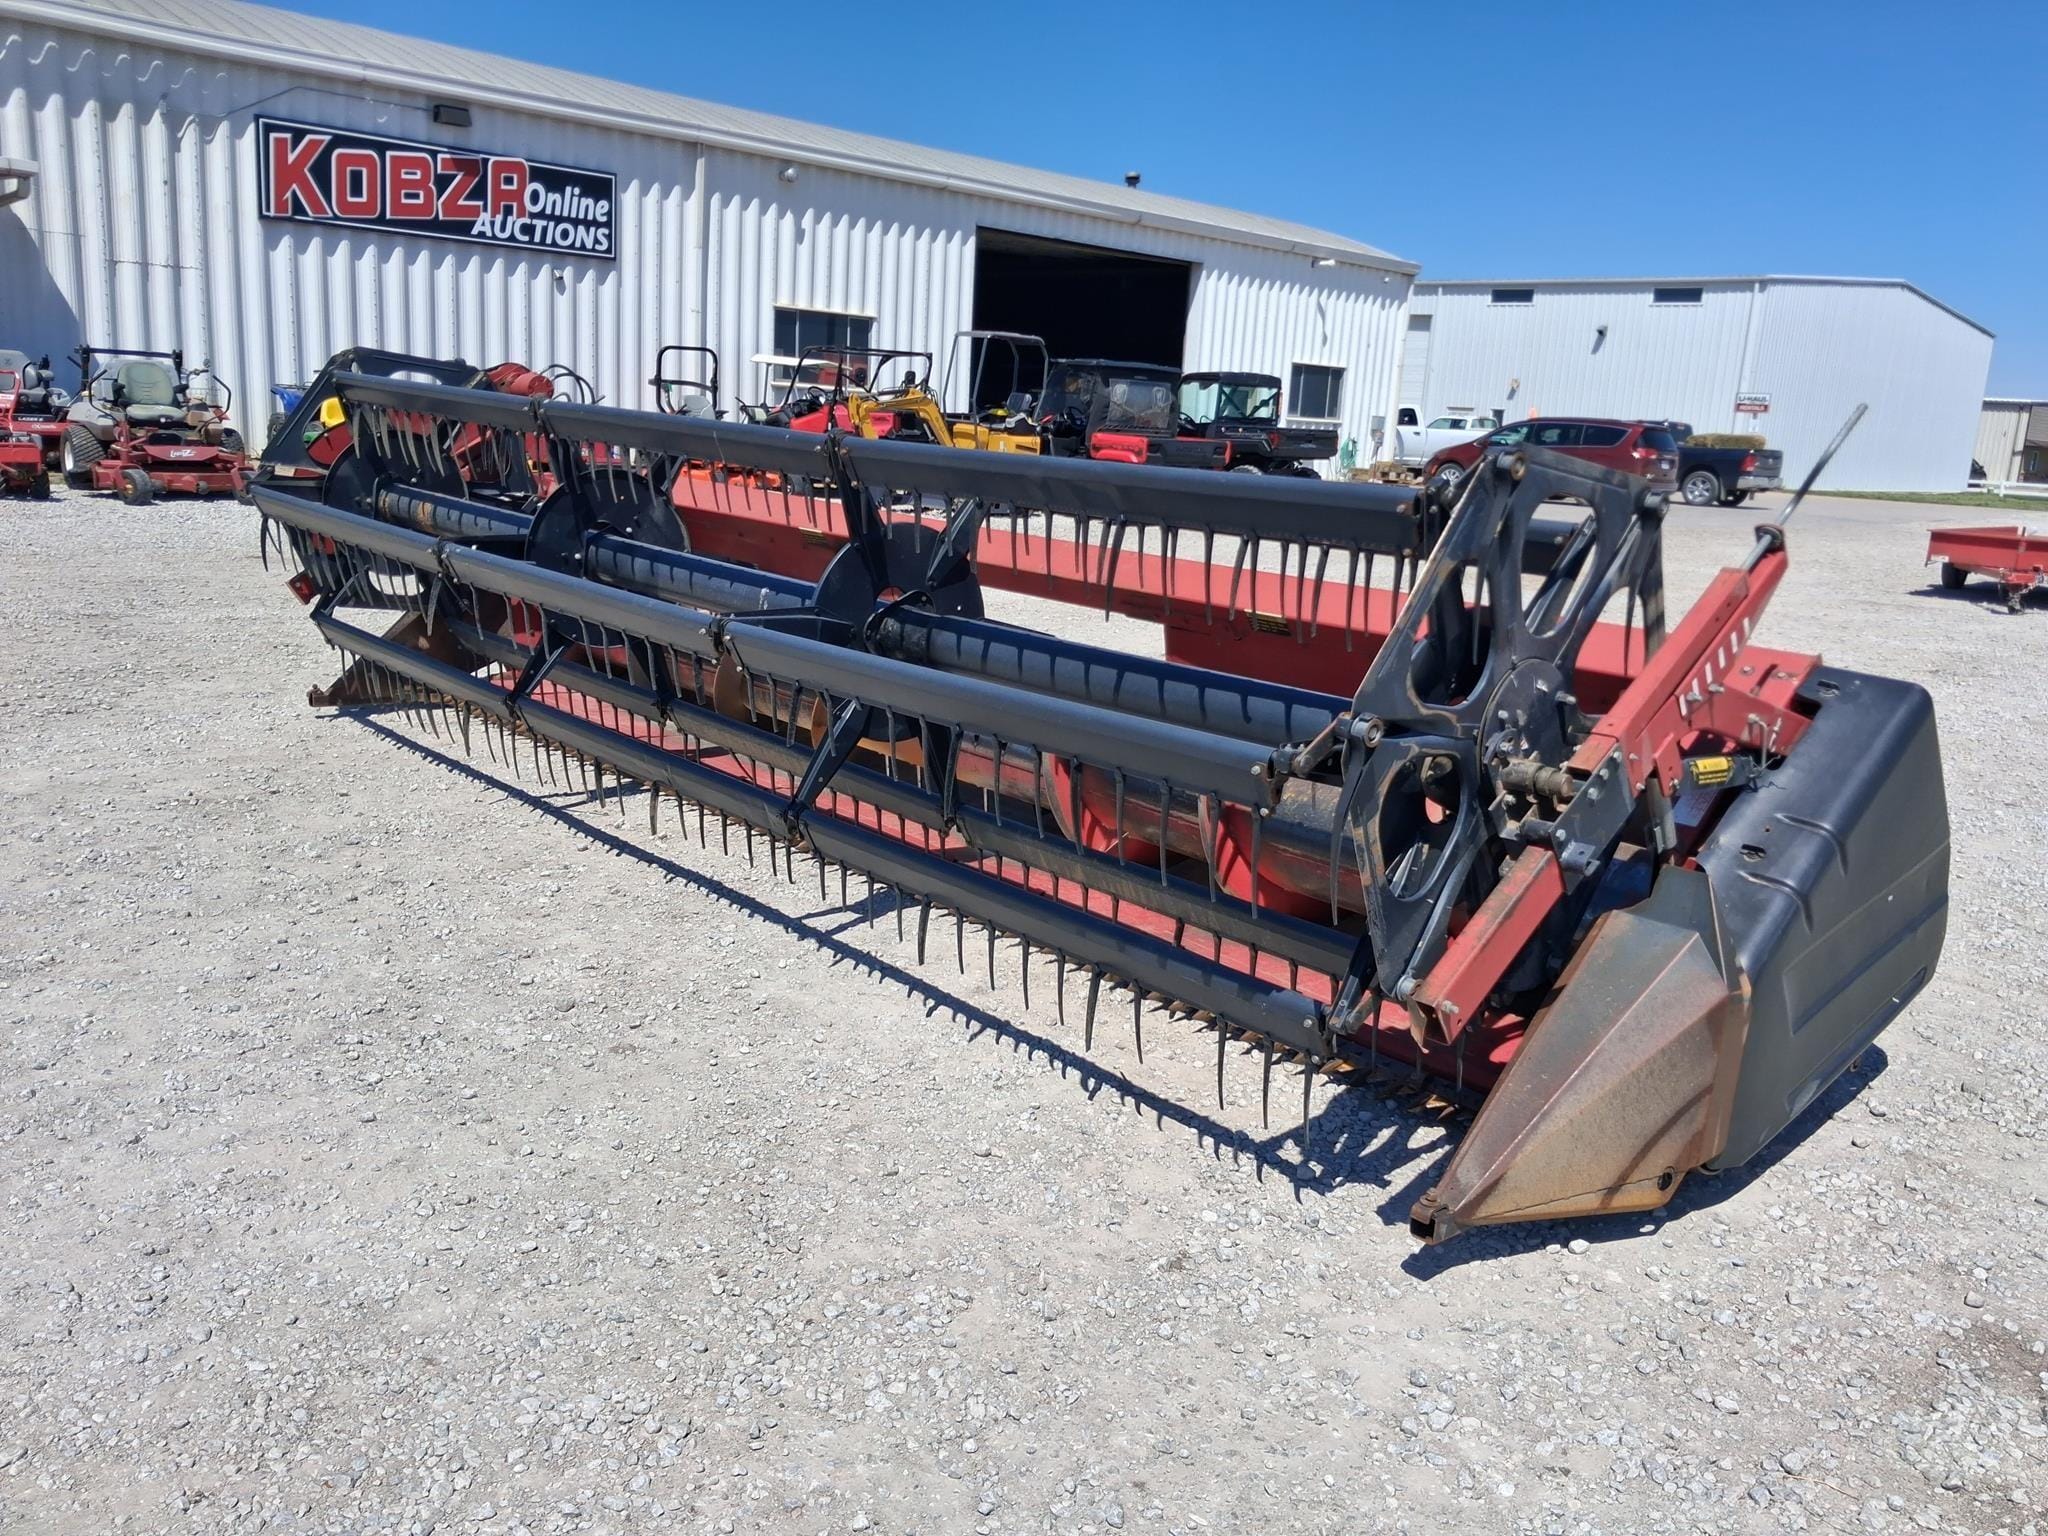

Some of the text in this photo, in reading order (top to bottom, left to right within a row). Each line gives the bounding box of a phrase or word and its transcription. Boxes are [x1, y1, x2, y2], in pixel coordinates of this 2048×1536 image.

[269, 132, 530, 220] KOBZA
[524, 182, 610, 222] Online
[470, 212, 610, 251] AUCTIONS
